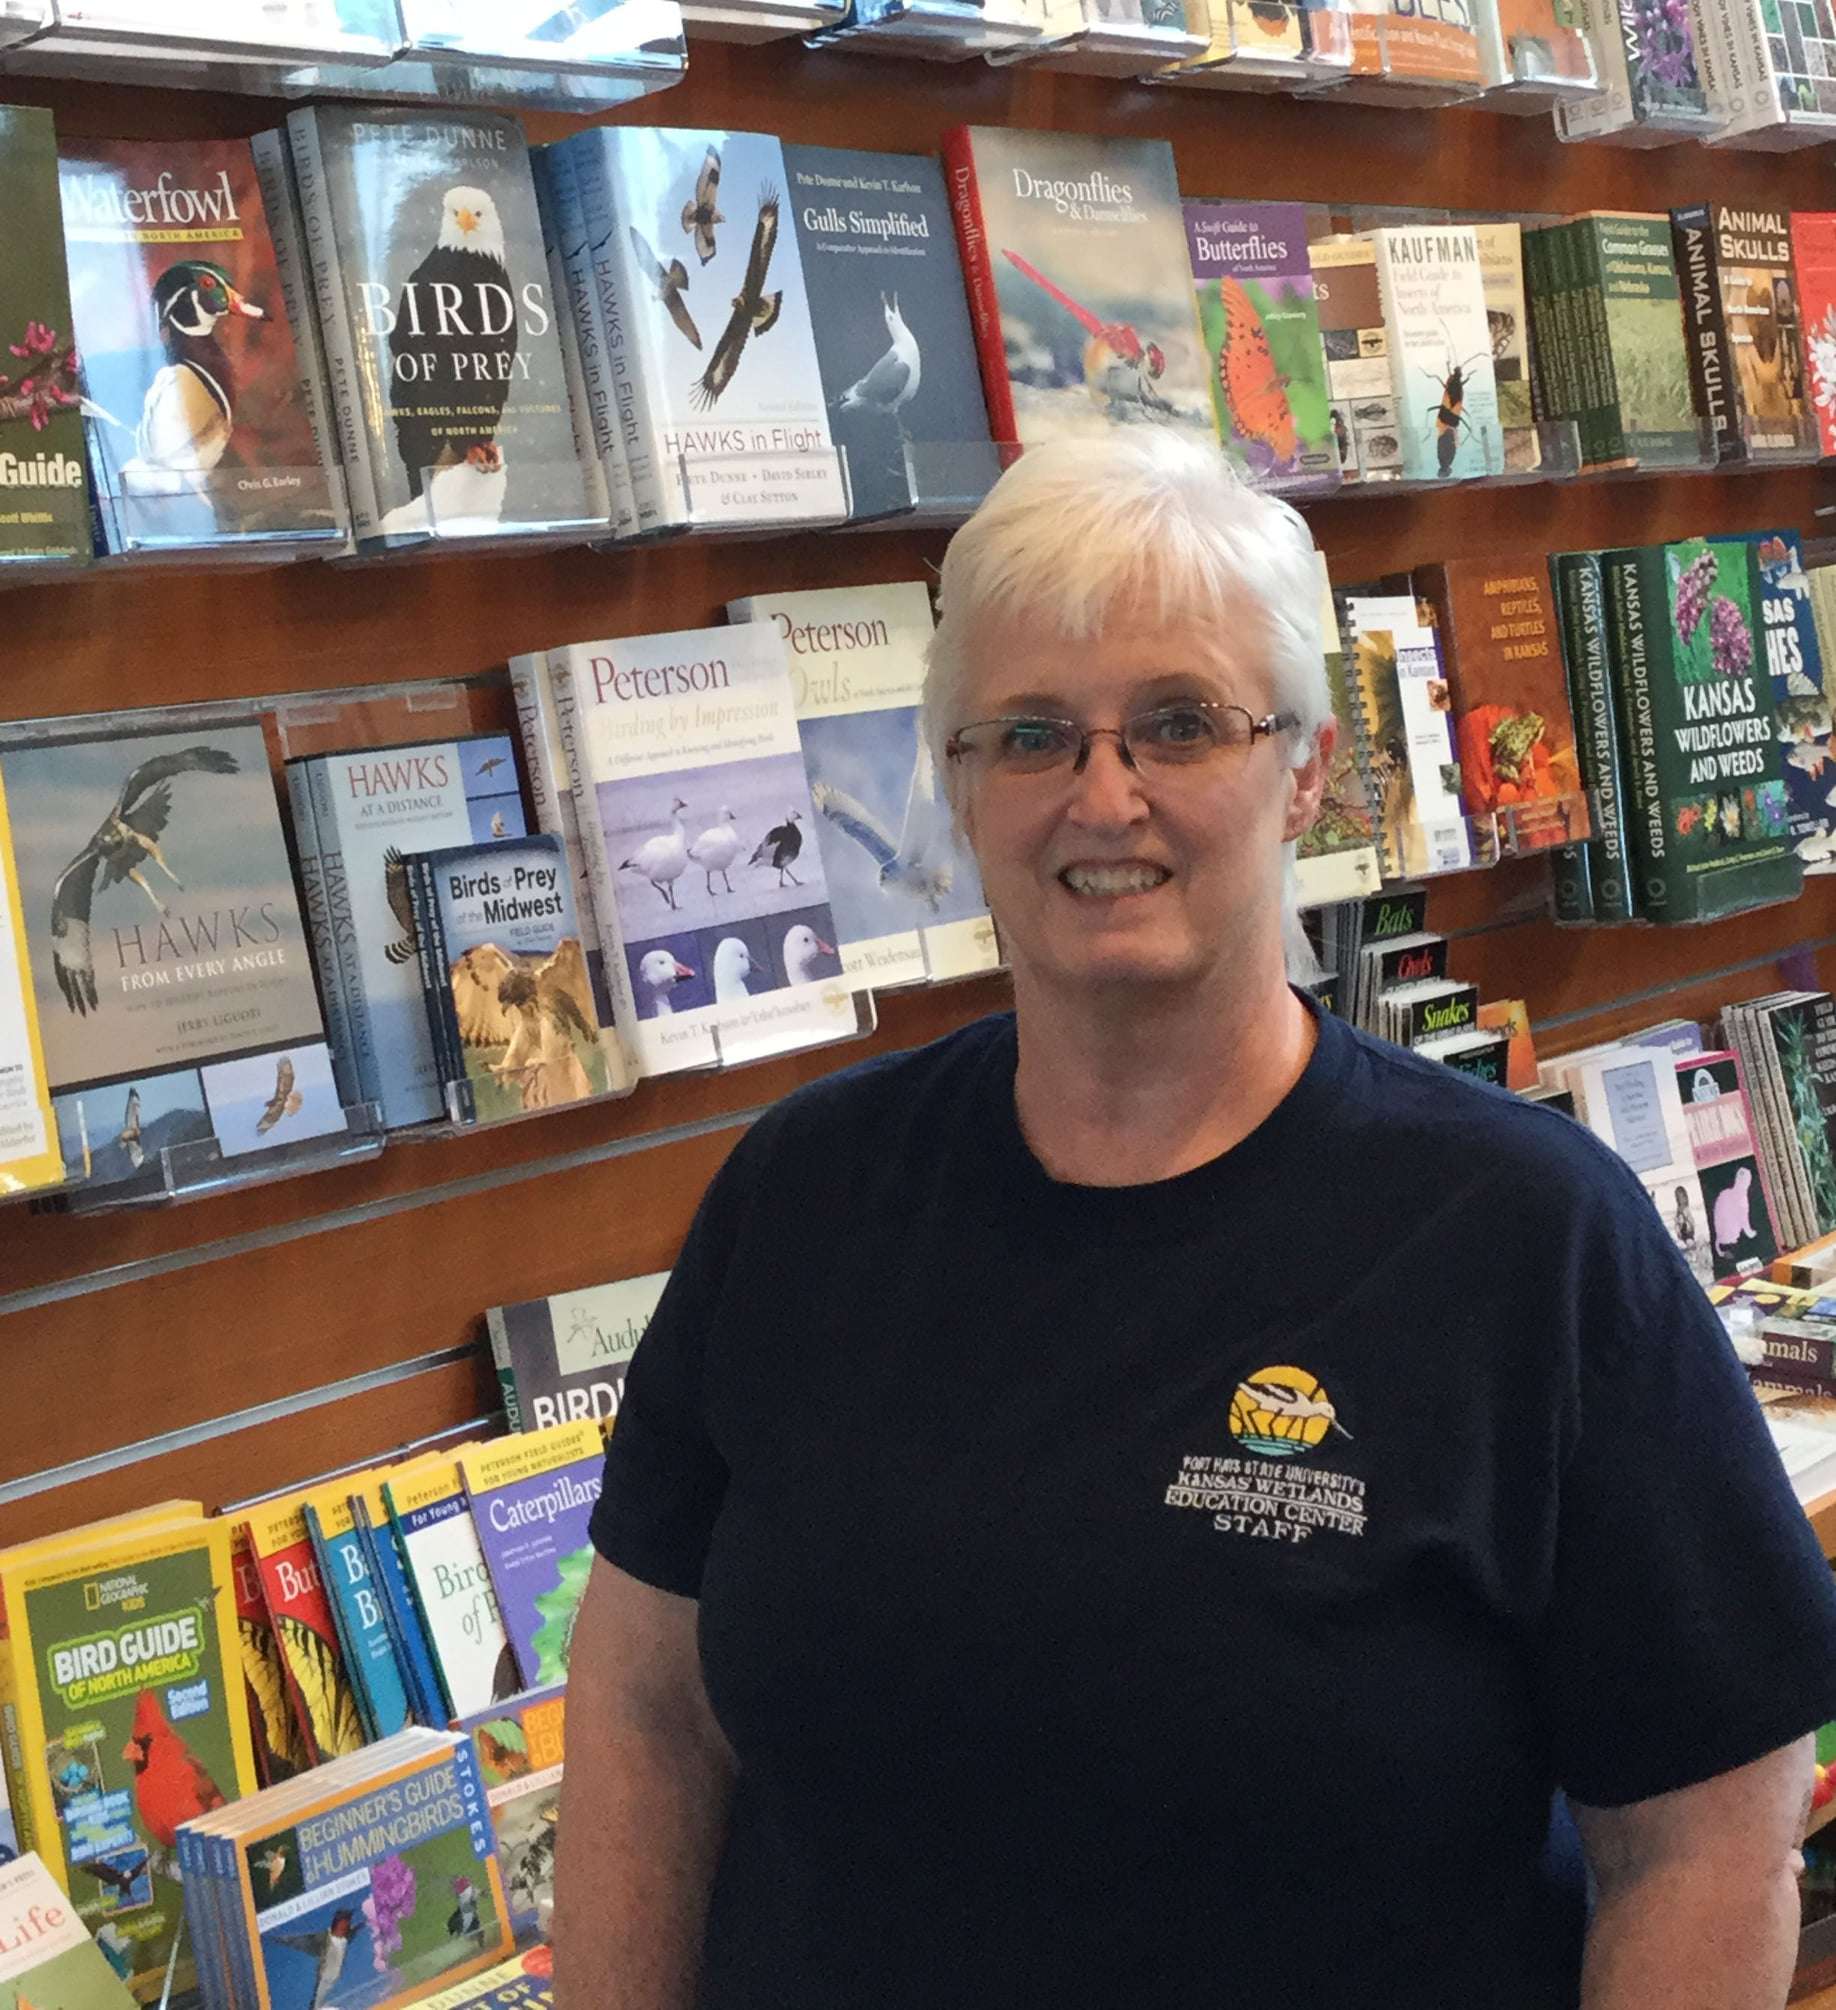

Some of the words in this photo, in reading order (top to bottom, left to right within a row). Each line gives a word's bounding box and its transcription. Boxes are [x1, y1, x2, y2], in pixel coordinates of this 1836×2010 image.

[353, 122, 414, 145] PETE
[426, 124, 507, 151] DUNNE
[66, 171, 241, 226] Waterfowl
[1012, 168, 1133, 213] Dragonflies
[294, 128, 321, 210] BIRDS
[316, 260, 336, 324] PREY
[803, 207, 848, 233] Gulls
[849, 210, 930, 241] Simplified
[954, 166, 981, 262] Dragonflies
[1070, 203, 1083, 221] &
[1194, 222, 1202, 233] A
[1201, 220, 1222, 236] Swift
[1222, 220, 1248, 234] Guide
[1249, 221, 1259, 233] to
[1719, 207, 1787, 235] ANIMAL
[142, 230, 183, 241] NORTH
[187, 229, 238, 240] AMERICA
[1196, 235, 1288, 261] Butterflies
[1388, 236, 1476, 264] KAUFMAN
[1720, 234, 1790, 262] SKULLS
[357, 282, 550, 338] BIRDS
[572, 268, 600, 360] HAWKS
[596, 259, 624, 348] HAWKS
[1685, 228, 1712, 325] ANIMAL
[1700, 331, 1727, 432] SKULLS
[331, 357, 353, 397] PETE
[395, 352, 438, 383] OF
[454, 351, 533, 382] PREY
[587, 364, 605, 384] in
[613, 355, 629, 376] in
[416, 405, 455, 418] EAGLES,
[456, 404, 500, 417] FALCONS,
[592, 389, 616, 454] Flight
[617, 380, 642, 445] Flight
[337, 405, 366, 465] DUNNE
[665, 430, 745, 454] HAWKS
[752, 430, 768, 449] in
[773, 427, 823, 453] Flight
[0, 453, 82, 487] Guide
[1579, 567, 1598, 633] KANSAS
[1623, 563, 1642, 630] KANSAS
[771, 612, 891, 654] Peterson
[1491, 624, 1509, 640] AND
[1509, 620, 1545, 637] TURTLES
[1513, 641, 1549, 658] KANSAS
[589, 656, 731, 706] Peterson
[1586, 637, 1610, 760] WILDFLOWERS
[1630, 635, 1654, 757] WILDFLOWERS
[1684, 678, 1757, 721] KANSAS
[669, 713, 690, 735] by
[694, 700, 780, 733] Impression
[1674, 715, 1771, 752] WILDFLOWERS
[518, 704, 547, 806] Peterson
[557, 696, 585, 799] Peterson
[1690, 756, 1718, 784] AND
[1718, 748, 1765, 778] WEEDS
[347, 755, 448, 798] HAWKS
[1597, 763, 1613, 800] AND
[1642, 760, 1658, 797] AND
[361, 803, 374, 818] AT
[377, 803, 385, 815] A
[387, 794, 443, 815] DISTANCE
[1600, 802, 1620, 859] WEEDS
[1647, 800, 1665, 858] WEEDS
[302, 857, 332, 950] HAWKS
[323, 850, 357, 944] HAWKS
[450, 872, 501, 900] Birds
[514, 866, 556, 891] Prey
[483, 892, 564, 925] Midwest
[1375, 903, 1414, 936] Bats
[112, 903, 281, 968] HAWKS
[121, 970, 171, 993] FROM
[175, 958, 226, 982] EVERY
[232, 948, 287, 973] ANGLE
[1398, 951, 1433, 980] Owls
[1422, 997, 1470, 1033] Snakes
[480, 1453, 522, 1473] PETERSON
[524, 1445, 549, 1460] FIELD
[483, 1473, 500, 1486] FOR
[501, 1467, 530, 1482] YOUNG
[531, 1447, 585, 1472] NATURALISTS
[1183, 1455, 1211, 1471] FORT
[1213, 1457, 1241, 1475] HAYS
[1244, 1460, 1283, 1478] STATE
[1286, 1464, 1366, 1497] UNIVERSITY'S
[406, 1484, 450, 1506] Peterson
[489, 1476, 602, 1532] Caterpillars
[1164, 1489, 1279, 1518] EDUCATION
[1284, 1502, 1365, 1536] CENTER
[1178, 1470, 1252, 1492] KANSAS
[1256, 1478, 1364, 1513] WETLANDS
[411, 1513, 428, 1527] For
[430, 1501, 461, 1521] Young
[1213, 1513, 1313, 1543] STAFF
[462, 1596, 483, 1646] of
[54, 1639, 117, 1685] BIRD
[119, 1616, 199, 1666] GUIDE
[68, 1681, 88, 1701] OF
[88, 1669, 133, 1696] NORTH
[134, 1652, 192, 1682] AMERICA
[167, 1680, 208, 1705] Second
[299, 1788, 403, 1853] BEGINNER'S
[405, 1766, 457, 1807] GUIDE
[455, 1749, 487, 1853] STOKES
[312, 1795, 466, 1881] HUMMINGBIRDS
[0, 1904, 66, 1954] Life
[259, 1904, 294, 1928] DONALD
